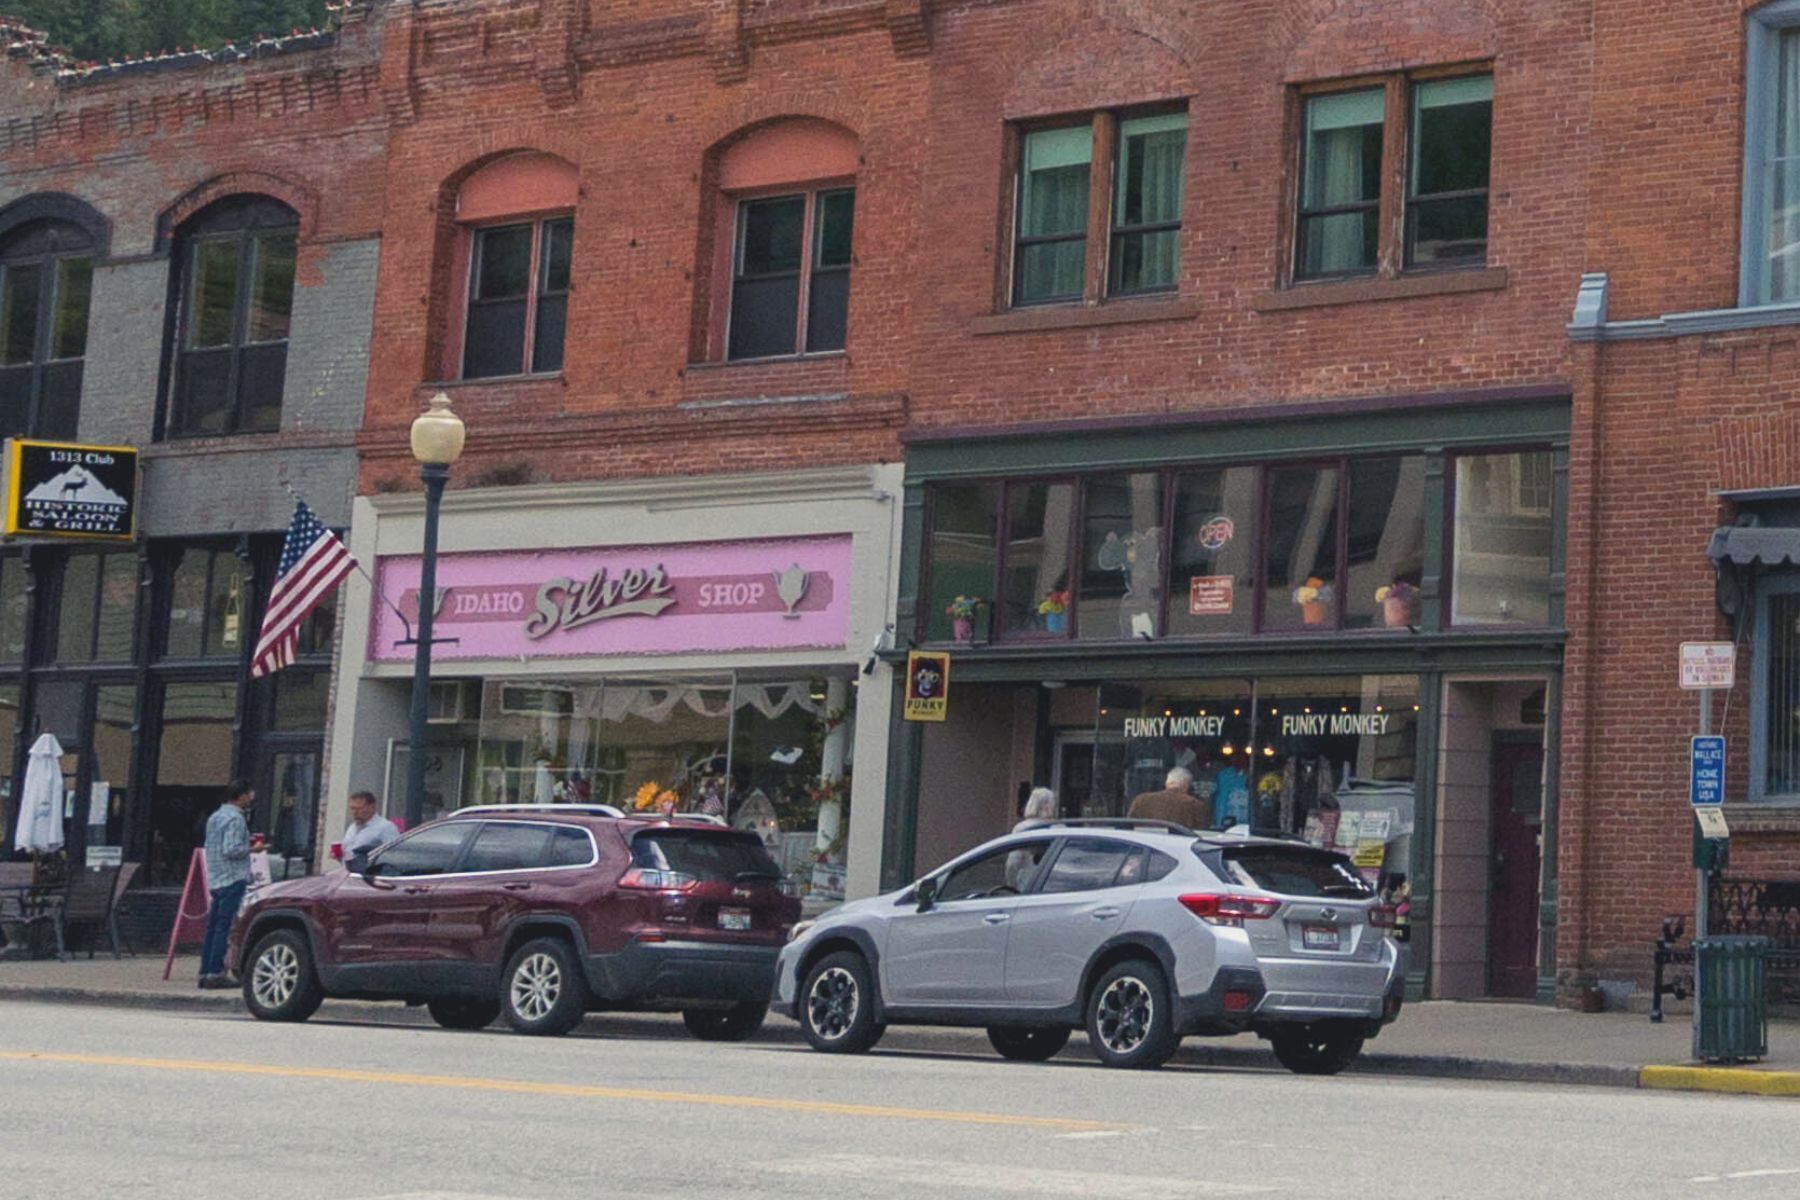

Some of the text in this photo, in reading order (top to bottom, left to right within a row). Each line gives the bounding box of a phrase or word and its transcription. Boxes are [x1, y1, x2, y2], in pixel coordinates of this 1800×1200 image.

[49, 450, 115, 466] 1313 Club
[25, 500, 128, 514] HISTORIC
[32, 510, 119, 523] SALOON
[54, 520, 121, 532] GRILL
[454, 563, 766, 641] IDAHO Silver SHOP
[906, 699, 945, 711] FUNKY
[1124, 716, 1225, 738] FUNKY MONKEY
[1282, 714, 1389, 736] FUNKY MONKEY
